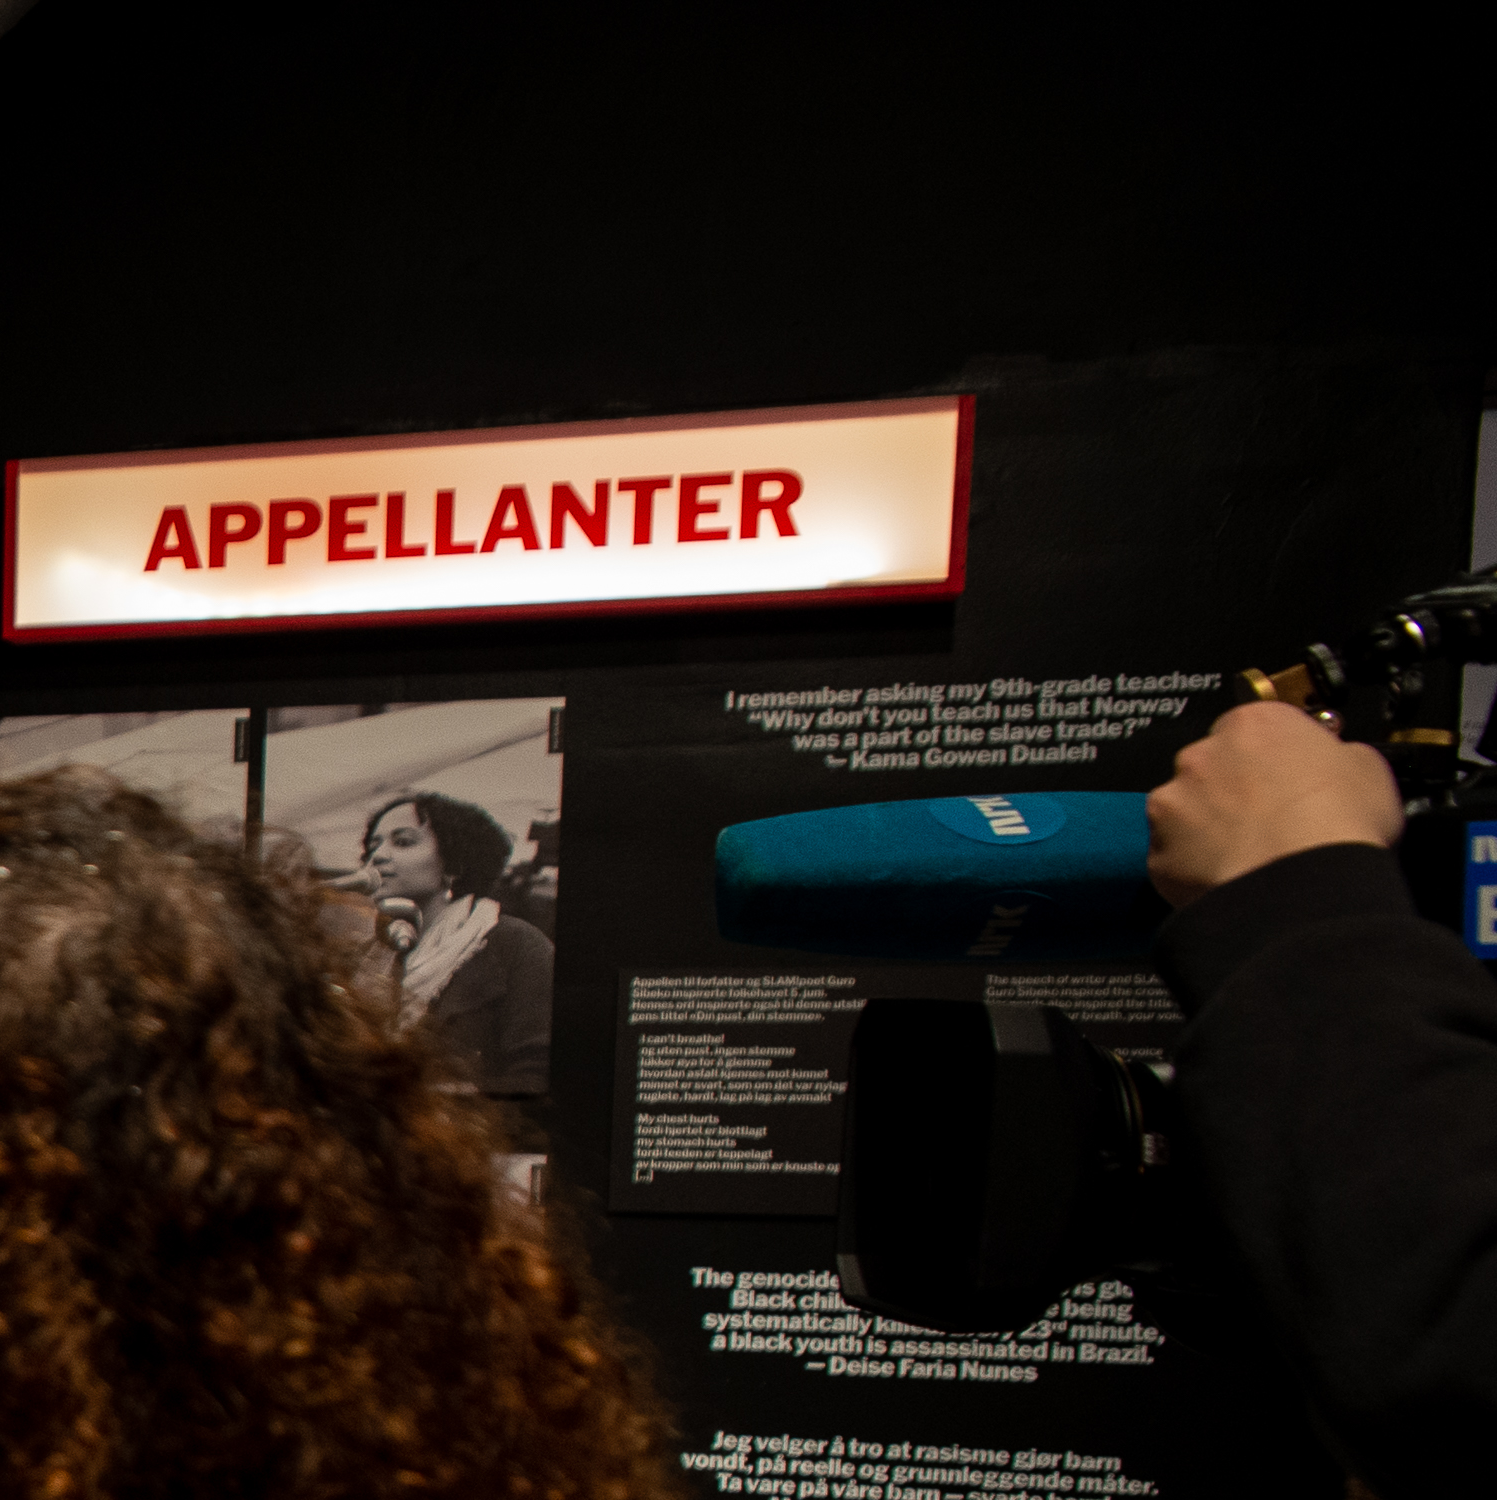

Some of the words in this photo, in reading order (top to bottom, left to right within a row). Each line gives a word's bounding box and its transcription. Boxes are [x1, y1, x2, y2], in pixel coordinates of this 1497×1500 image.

[144, 468, 803, 571] APPELLANTER
[726, 690, 734, 709] I
[738, 686, 862, 708] remember
[864, 683, 946, 705] asking
[949, 684, 987, 704] my
[990, 675, 1112, 700] 9th-grade
[1116, 672, 1222, 692] teacher:
[883, 708, 928, 729] you
[931, 700, 1000, 722] teach
[1004, 703, 1034, 718] us
[1037, 696, 1090, 717] that
[1094, 696, 1188, 716] Norway
[792, 732, 840, 748] was
[844, 731, 858, 746] a
[862, 725, 912, 750] part
[914, 724, 942, 743] of
[944, 723, 985, 742] the
[988, 721, 1052, 740] slave
[850, 749, 920, 768] Kama
[922, 747, 1007, 765] Gowen
[1010, 741, 1098, 762] Dualeh
[691, 1267, 734, 1287] The
[731, 1289, 796, 1310] Black
[1062, 1297, 1134, 1323] being
[703, 1310, 874, 1338] systematically
[1070, 1321, 1165, 1346] minute,
[710, 1334, 726, 1349] a
[728, 1330, 793, 1351] black
[794, 1334, 863, 1357] youth
[865, 1335, 886, 1355] is
[888, 1338, 1048, 1360] assassinated
[1052, 1341, 1075, 1361] in
[1078, 1342, 1154, 1363] Brazil.
[828, 1355, 894, 1376] Deise
[898, 1357, 956, 1379] Faria
[960, 1360, 1038, 1382] Nunes
[712, 1430, 753, 1456] Jeg
[754, 1434, 828, 1459] velger
[830, 1436, 845, 1456] å
[848, 1438, 884, 1459] tro
[886, 1440, 912, 1460] at
[914, 1444, 1010, 1466] rasisme
[1012, 1448, 1062, 1472] gjør
[1064, 1450, 1122, 1472] barn
[680, 1451, 754, 1475] vondt,
[757, 1454, 786, 1478] på
[789, 1457, 856, 1478] reelle
[858, 1464, 890, 1485] og
[892, 1465, 1074, 1493] grunnleggende
[1076, 1473, 1159, 1496] måter.
[716, 1471, 742, 1492] Ta
[744, 1477, 796, 1495] vare
[798, 1477, 828, 1500] på
[830, 1479, 884, 1500] våre
